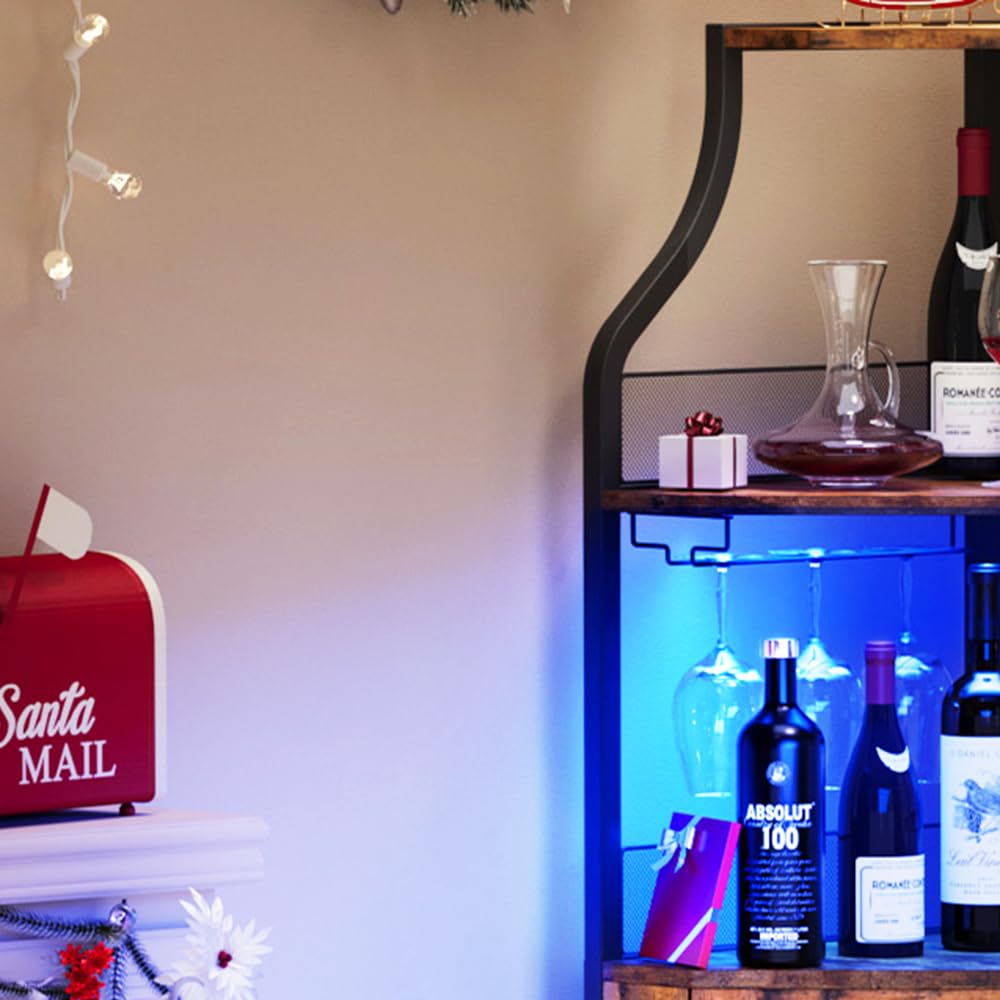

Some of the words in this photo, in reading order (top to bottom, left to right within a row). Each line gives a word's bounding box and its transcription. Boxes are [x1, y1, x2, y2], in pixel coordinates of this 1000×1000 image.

[0, 681, 95, 748] Santa
[19, 740, 117, 785] MAIL
[744, 803, 812, 821] ABSOLUT
[761, 826, 799, 850] 100
